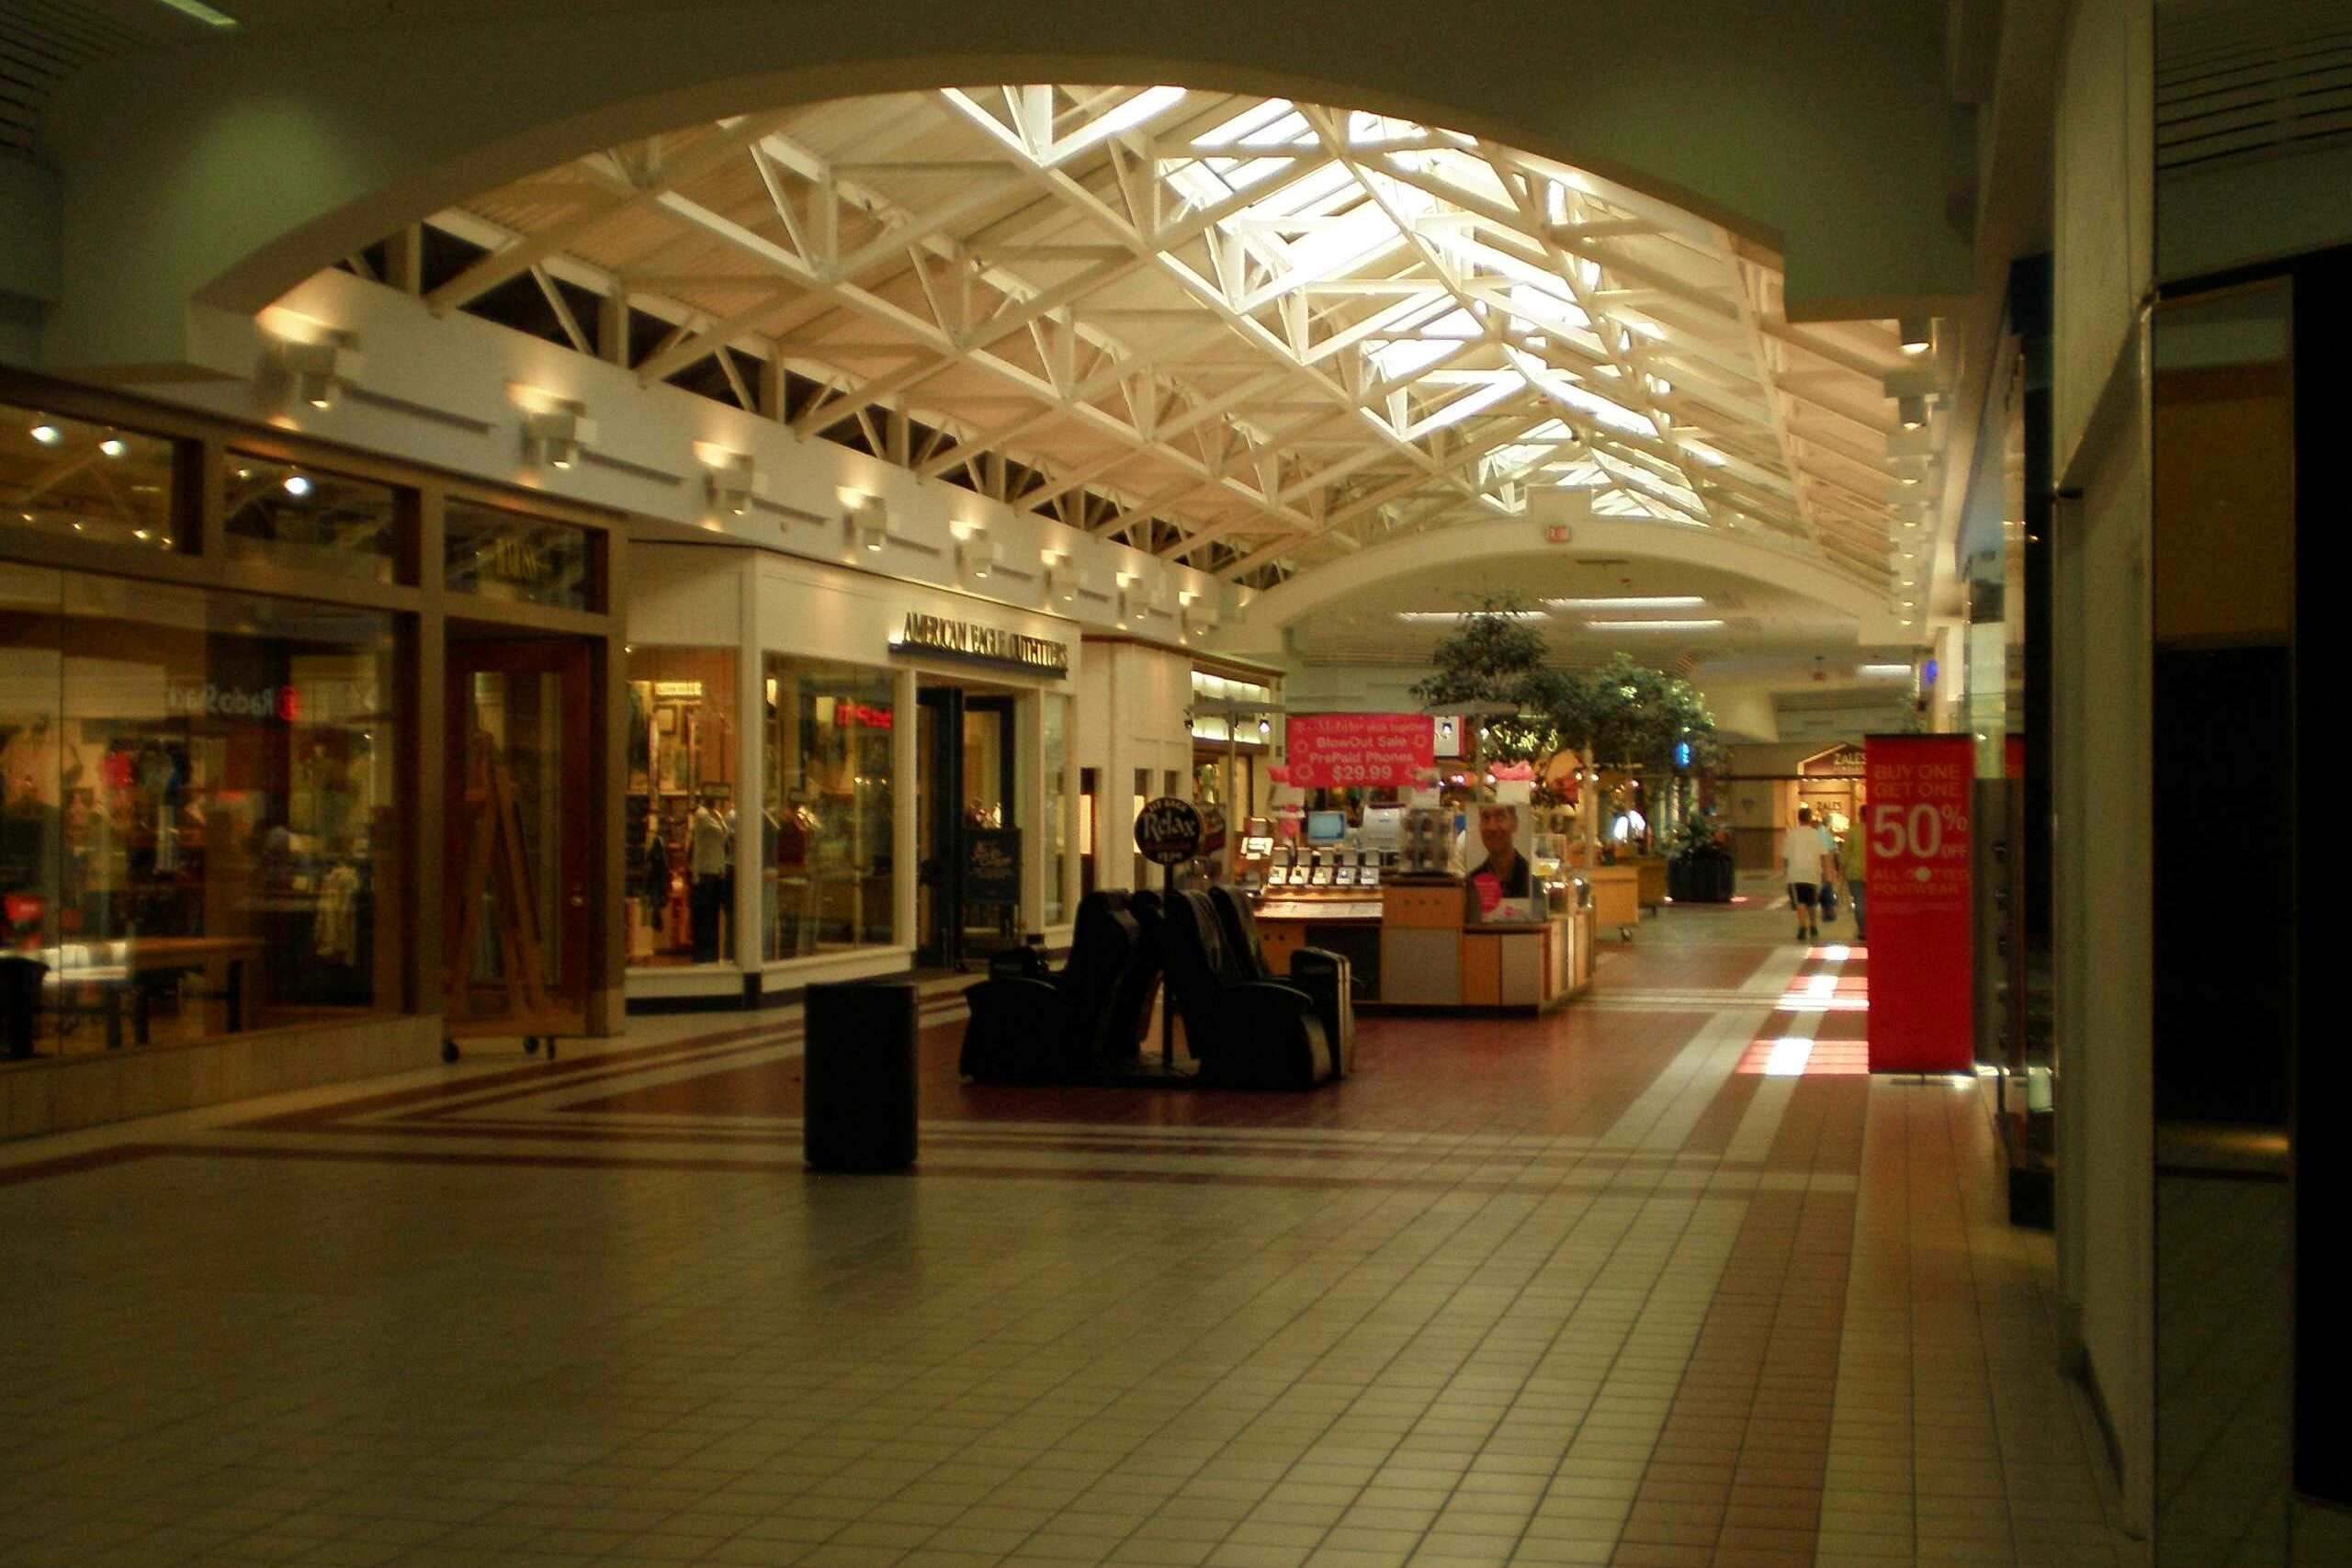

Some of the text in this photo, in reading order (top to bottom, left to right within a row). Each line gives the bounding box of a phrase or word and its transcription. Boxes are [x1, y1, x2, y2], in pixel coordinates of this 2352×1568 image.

[903, 611, 1069, 669] AMERICAN EAGLE OUTFITTERS
[1316, 736, 1408, 749] BlowOut Sale
[1308, 751, 1415, 764] PrePaid Phones
[1333, 765, 1393, 782] $29.99
[1873, 764, 1913, 780] BUY
[1917, 764, 1961, 780] ONE
[1874, 782, 1960, 797] GET ONE
[1939, 844, 1970, 859] OFF
